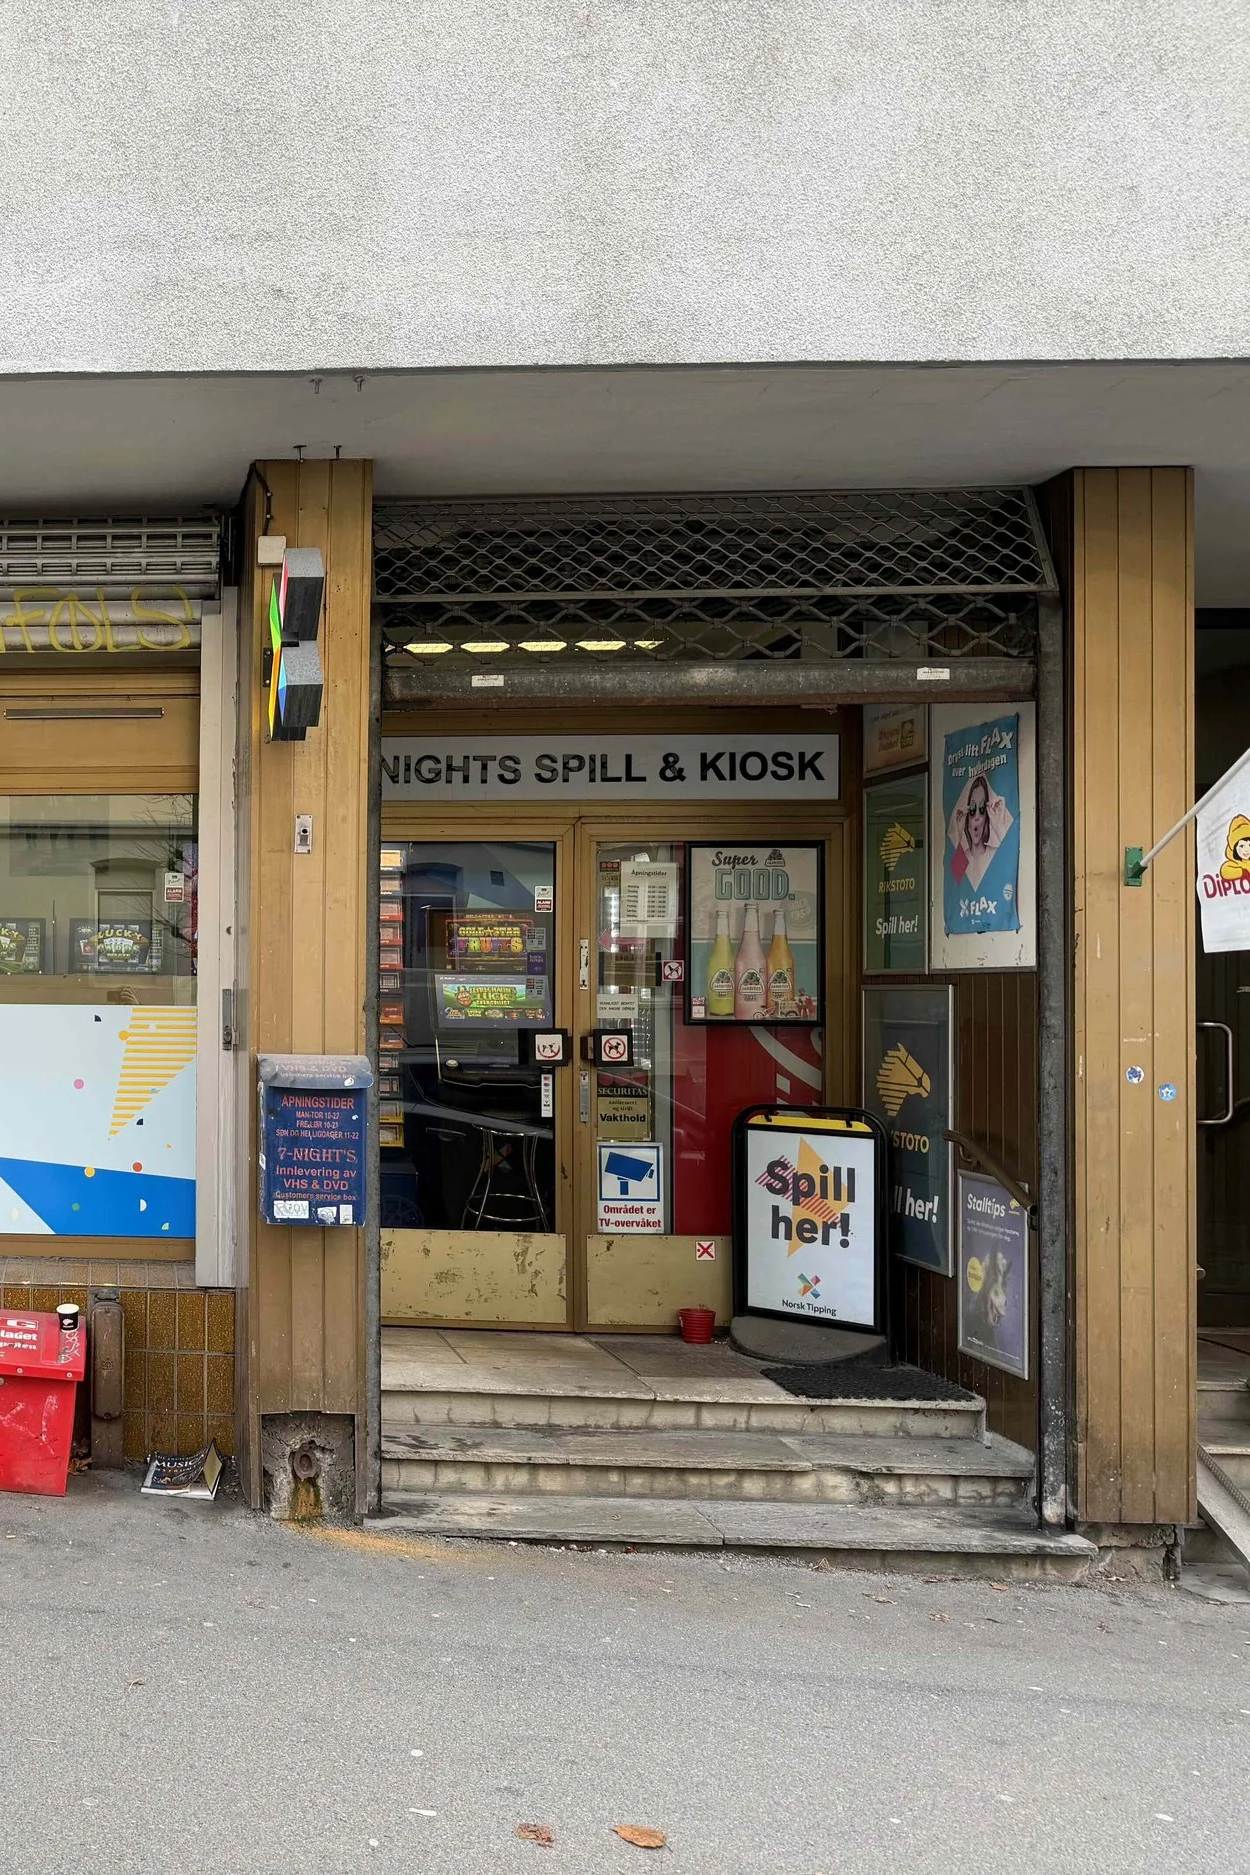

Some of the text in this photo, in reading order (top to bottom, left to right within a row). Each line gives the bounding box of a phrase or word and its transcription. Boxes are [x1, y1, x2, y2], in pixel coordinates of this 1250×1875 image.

[965, 744, 979, 757] litt
[980, 727, 1013, 754] FLAX
[381, 750, 825, 784] NIGHTS SPILL & KIOSK
[968, 754, 1007, 777] hverdagen
[712, 851, 758, 869] Super
[715, 868, 795, 900] GOOD.
[879, 878, 915, 893] RIKSTOTO
[970, 896, 997, 915] FLAX
[98, 929, 142, 940] LUCKY
[875, 915, 918, 939] Spill her!
[598, 1087, 648, 1096] SECURITAS
[600, 1113, 646, 1122] Vakthold
[891, 1130, 930, 1153] STOTO
[276, 1165, 357, 1179] Innlevering av
[283, 1178, 349, 1191] VHS & DVD
[765, 1159, 856, 1206] Spill
[603, 1204, 656, 1214] Området er
[905, 1188, 939, 1223] her!
[967, 1193, 1006, 1218] Stalltips
[599, 1218, 661, 1228] TV-overvåket
[771, 1204, 850, 1248] her!
[782, 1299, 837, 1317] Norsk Tipping
